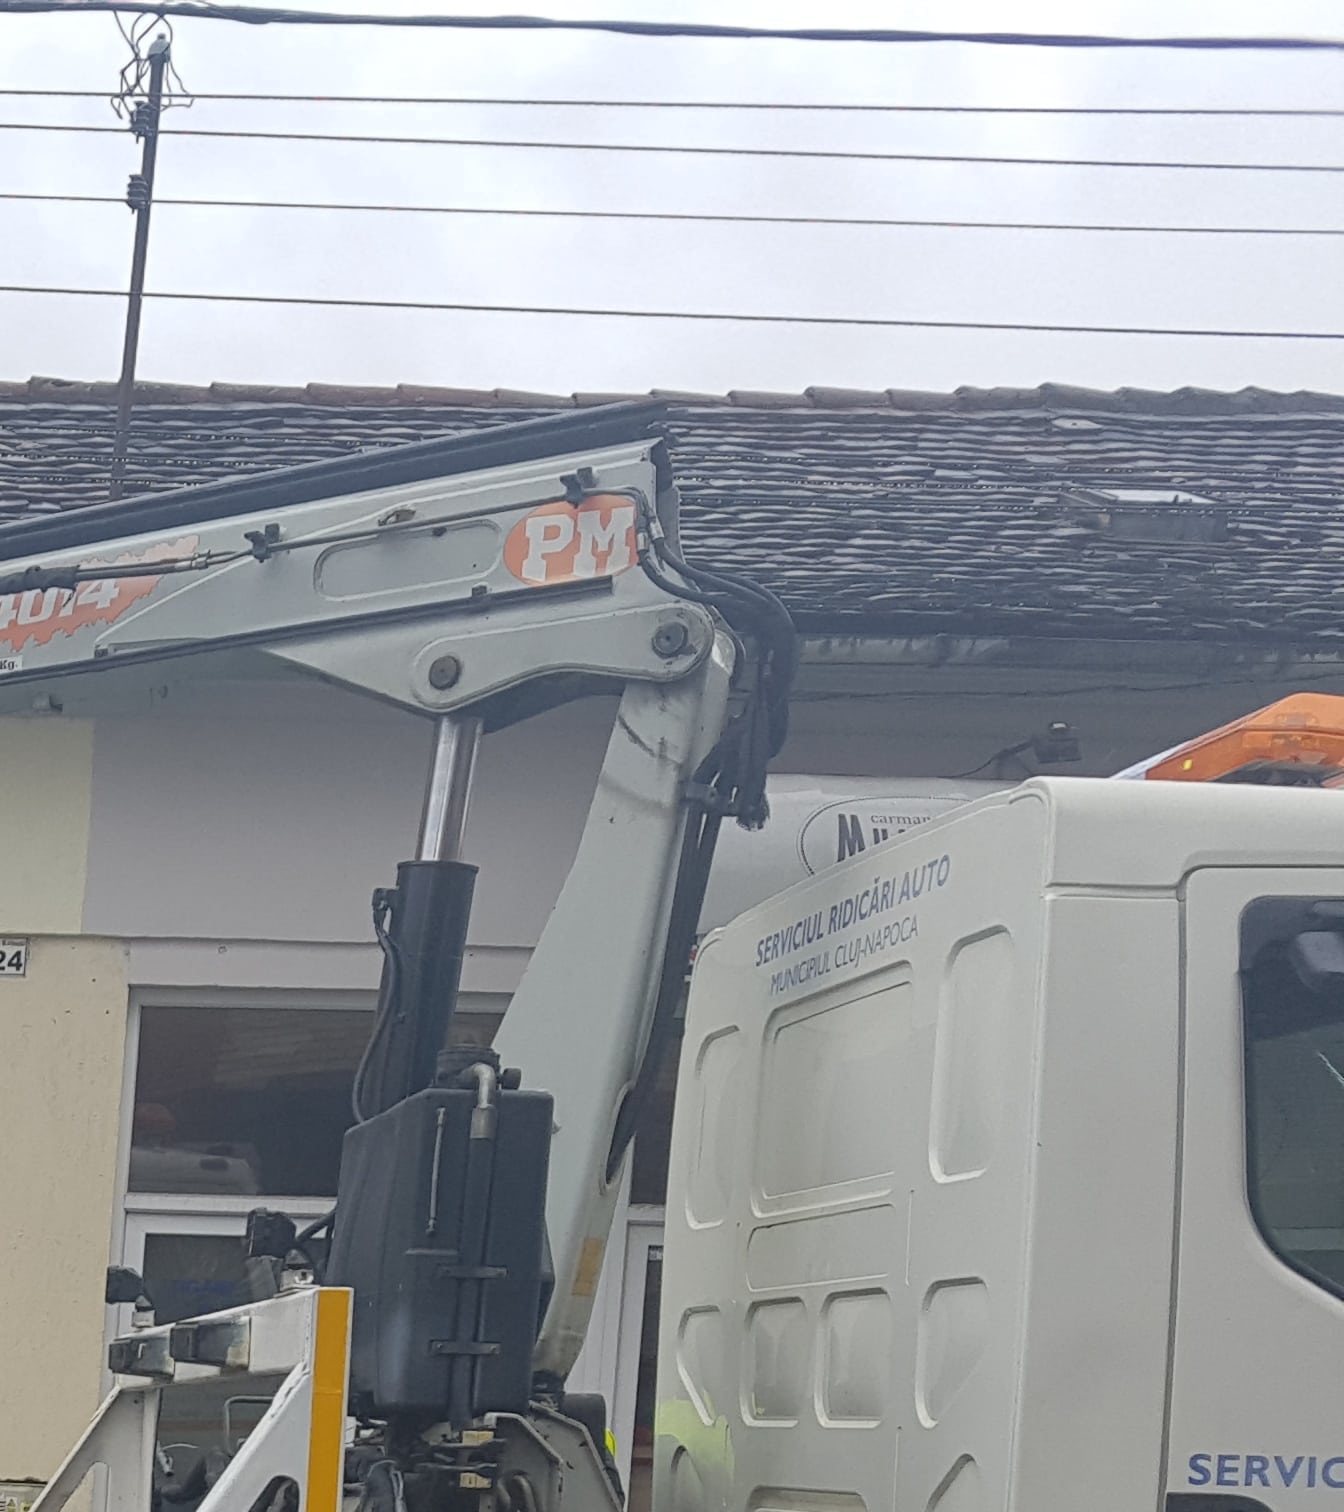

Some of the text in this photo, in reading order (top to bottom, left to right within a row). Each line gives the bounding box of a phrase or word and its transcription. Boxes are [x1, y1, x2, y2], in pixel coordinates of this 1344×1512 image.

[521, 506, 635, 583] PM
[0, 658, 19, 673] Kg.
[756, 854, 951, 967] SERVICIUL RIDICĂRI AUTO
[770, 913, 919, 996] MUNICIPIUL CLUJ-NAPOCA
[1188, 1453, 1344, 1489] SERVIC
